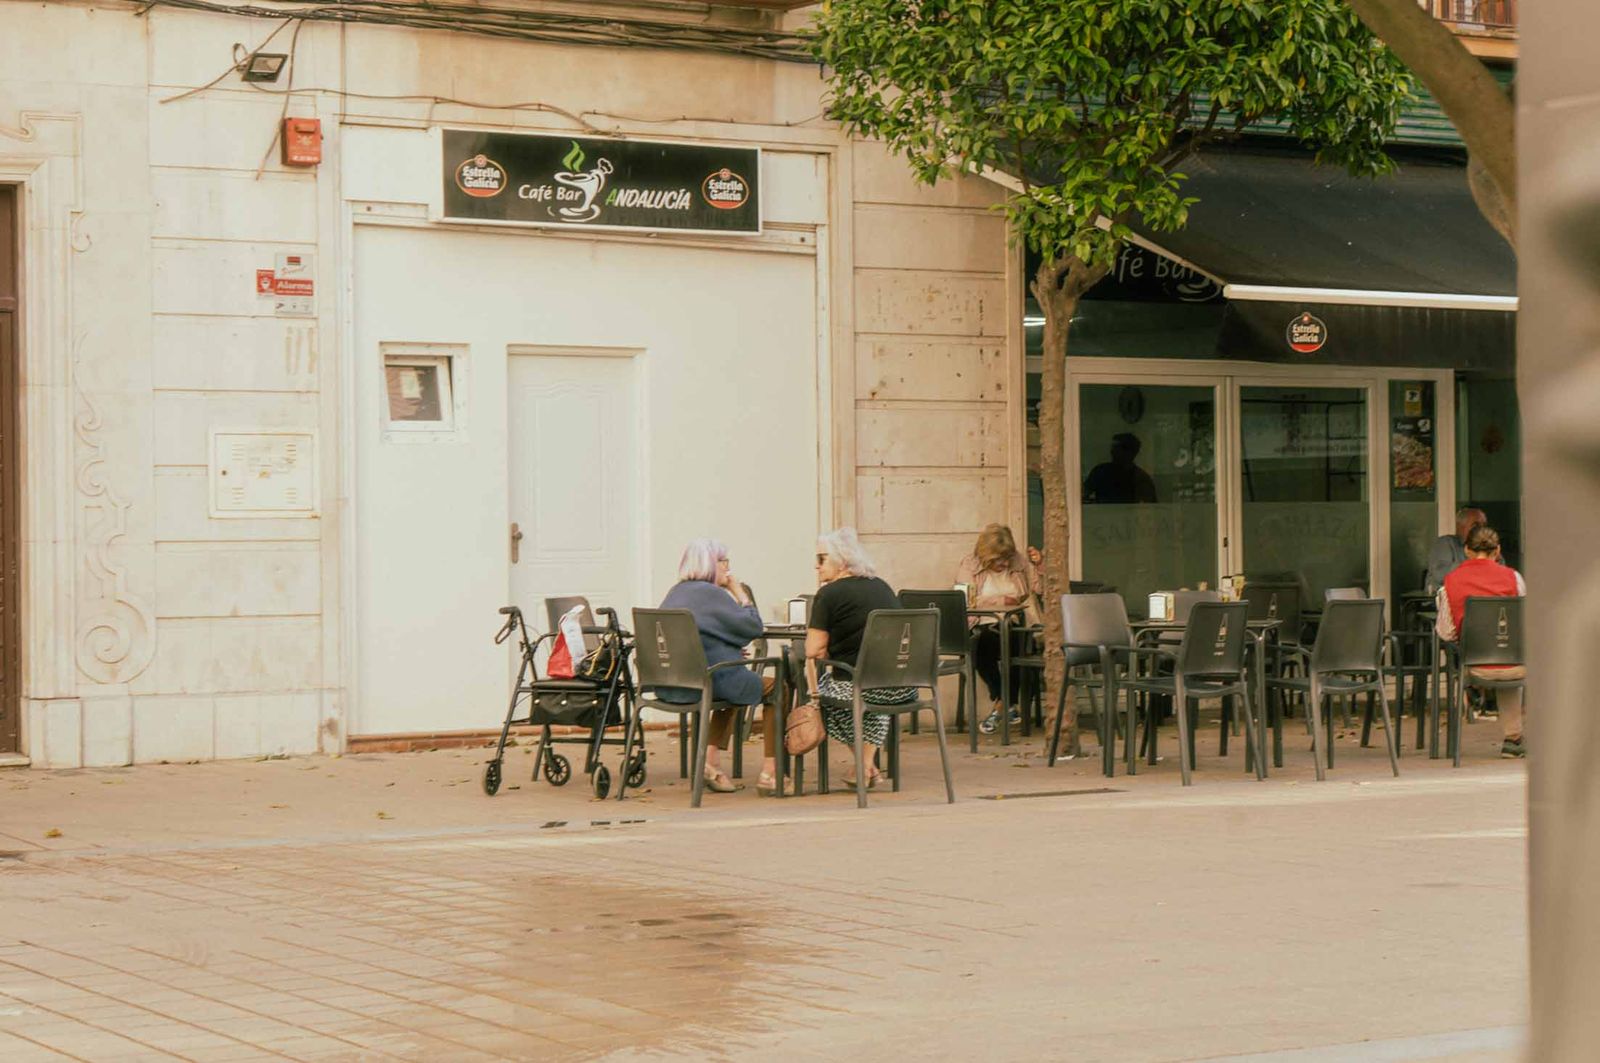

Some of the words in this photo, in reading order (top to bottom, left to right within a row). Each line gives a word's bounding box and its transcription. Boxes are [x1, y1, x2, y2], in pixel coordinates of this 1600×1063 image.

[462, 165, 501, 179] Estrella
[463, 176, 499, 189] Galicia
[708, 179, 744, 191] Estrella
[518, 184, 553, 202] Café
[556, 186, 582, 201] Bar
[605, 188, 691, 210] ANDALUCÍA
[709, 189, 742, 201] Galicia
[1104, 248, 1144, 284] fé
[1292, 323, 1320, 334] Estrella
[1293, 332, 1319, 343] Galicia
